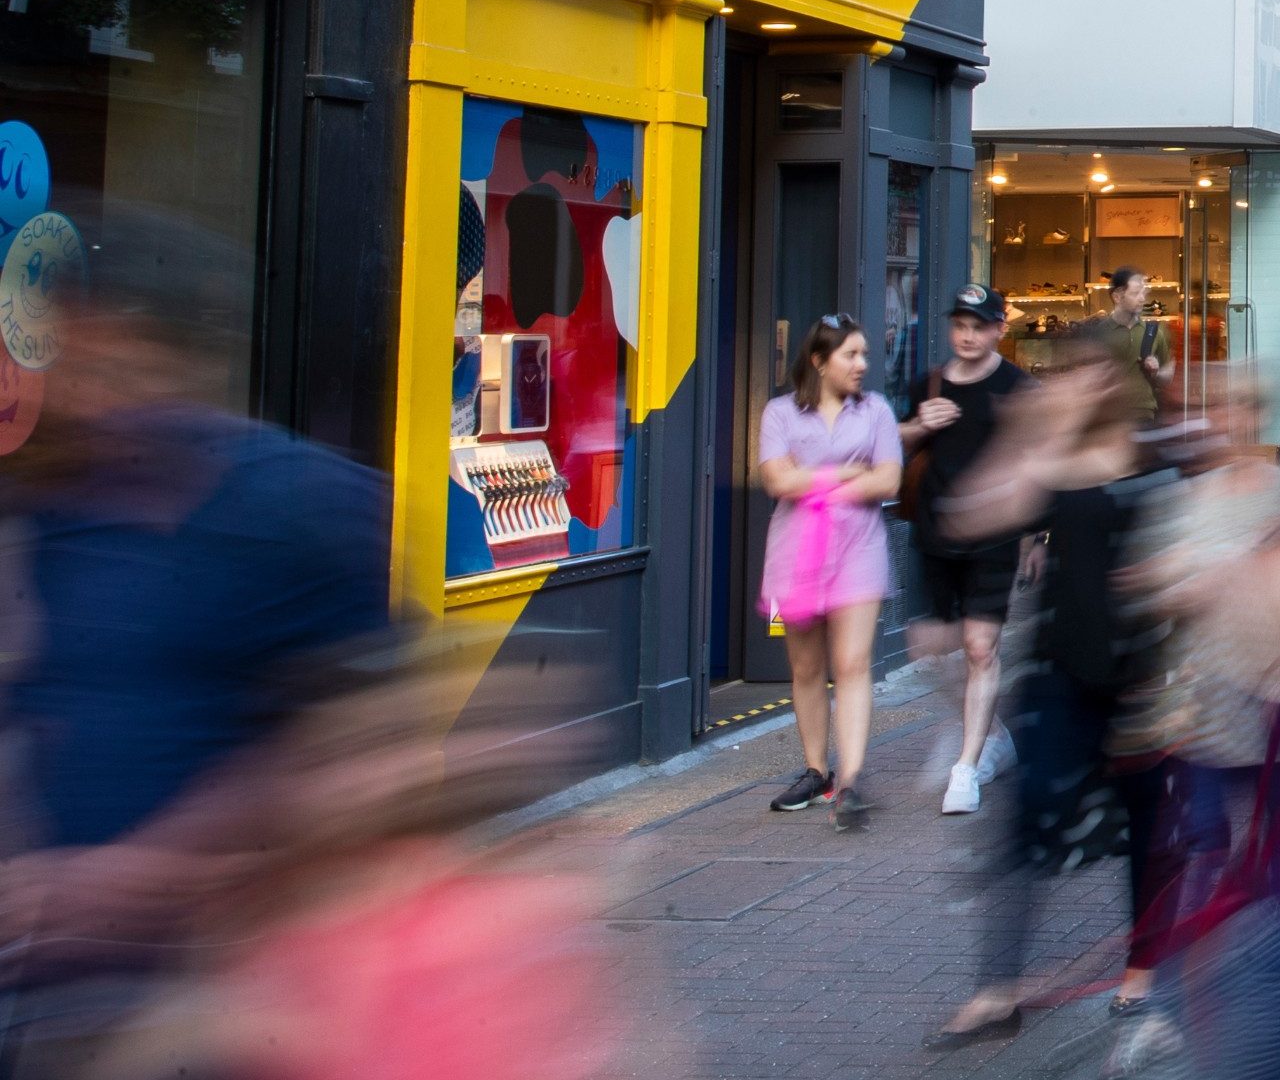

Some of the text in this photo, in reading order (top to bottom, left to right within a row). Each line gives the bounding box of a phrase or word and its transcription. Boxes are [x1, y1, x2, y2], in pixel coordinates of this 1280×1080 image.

[21, 216, 68, 248] SOAK
[1, 292, 60, 360] THE SUN
